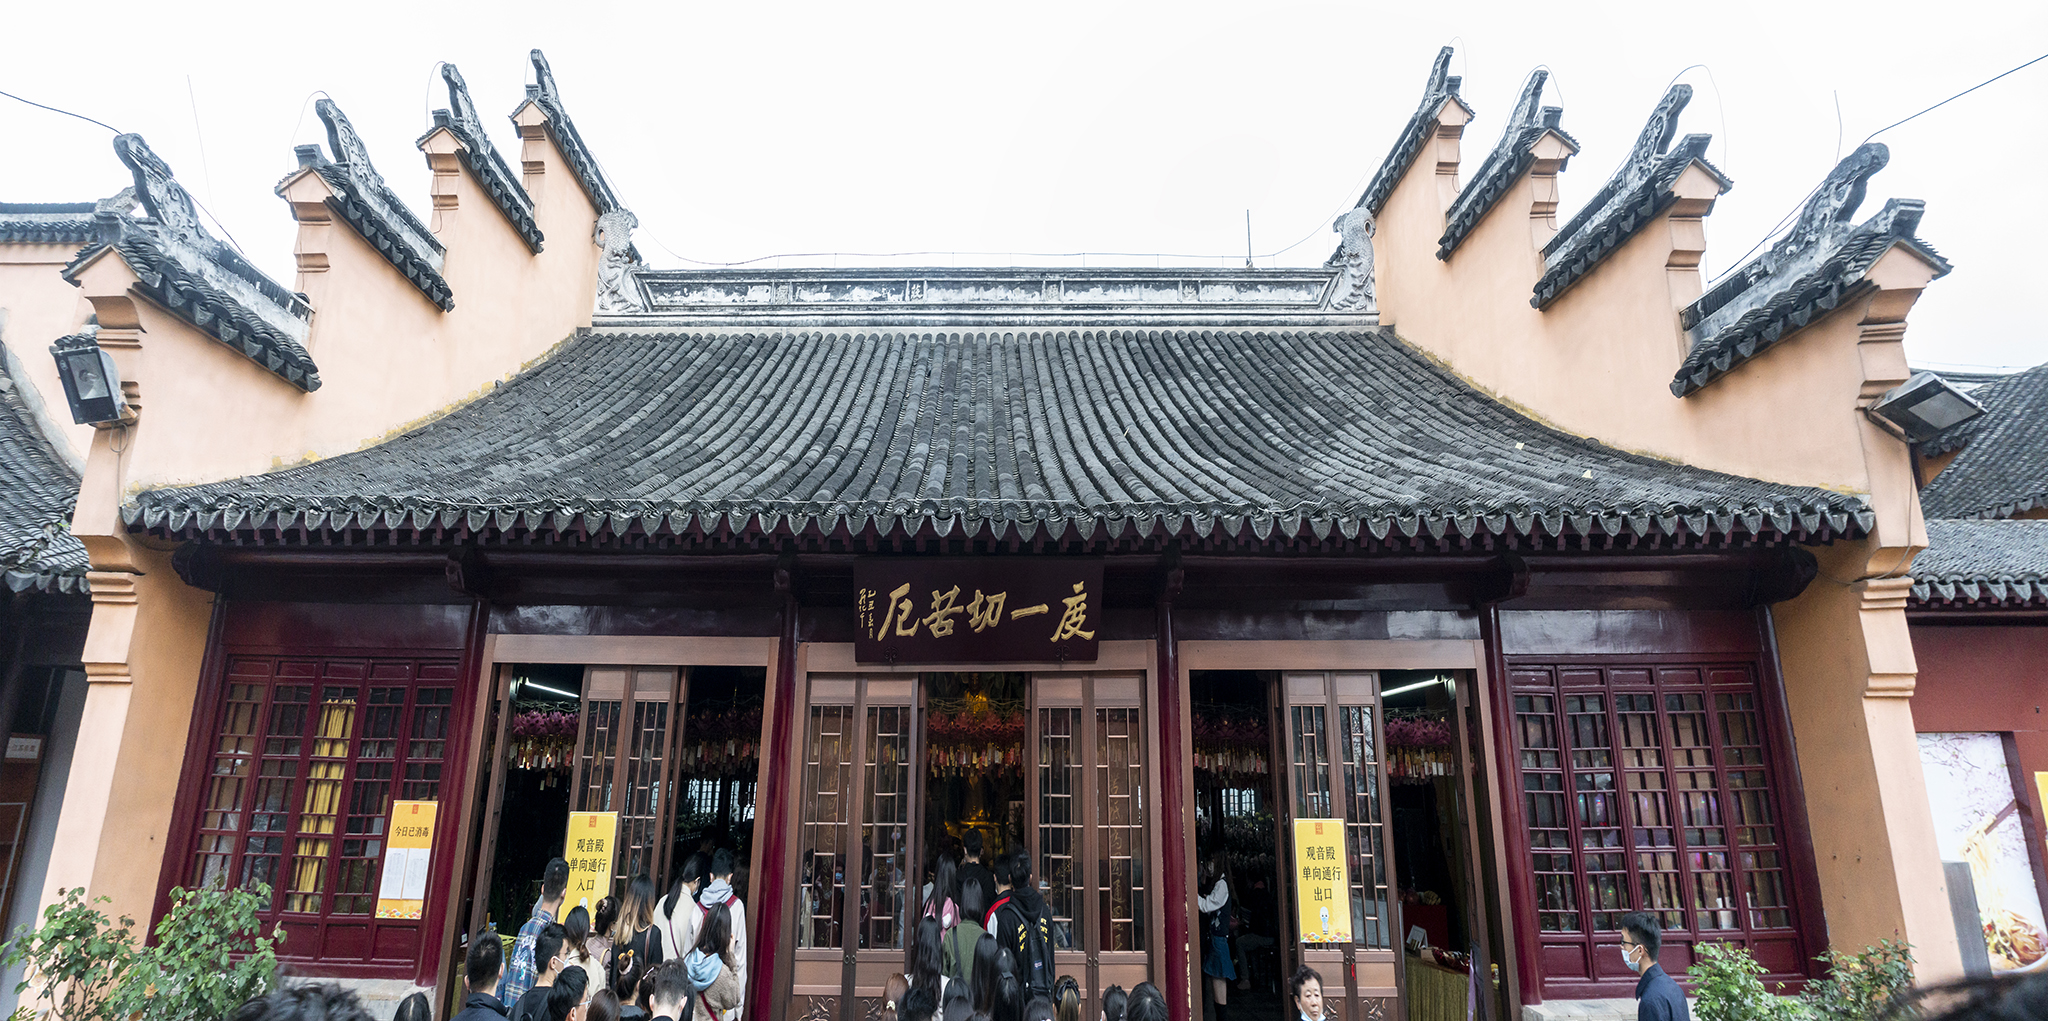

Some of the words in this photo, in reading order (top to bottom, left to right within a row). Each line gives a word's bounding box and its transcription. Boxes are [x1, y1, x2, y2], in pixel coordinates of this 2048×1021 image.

[395, 826, 429, 837] 今日已消毒
[576, 838, 604, 853] 观音殿
[1306, 846, 1335, 860] 观音殿
[569, 858, 606, 873] 单向通行
[1303, 866, 1341, 881] 单向通行
[576, 879, 594, 891] 入口
[1314, 887, 1332, 901] 出口
